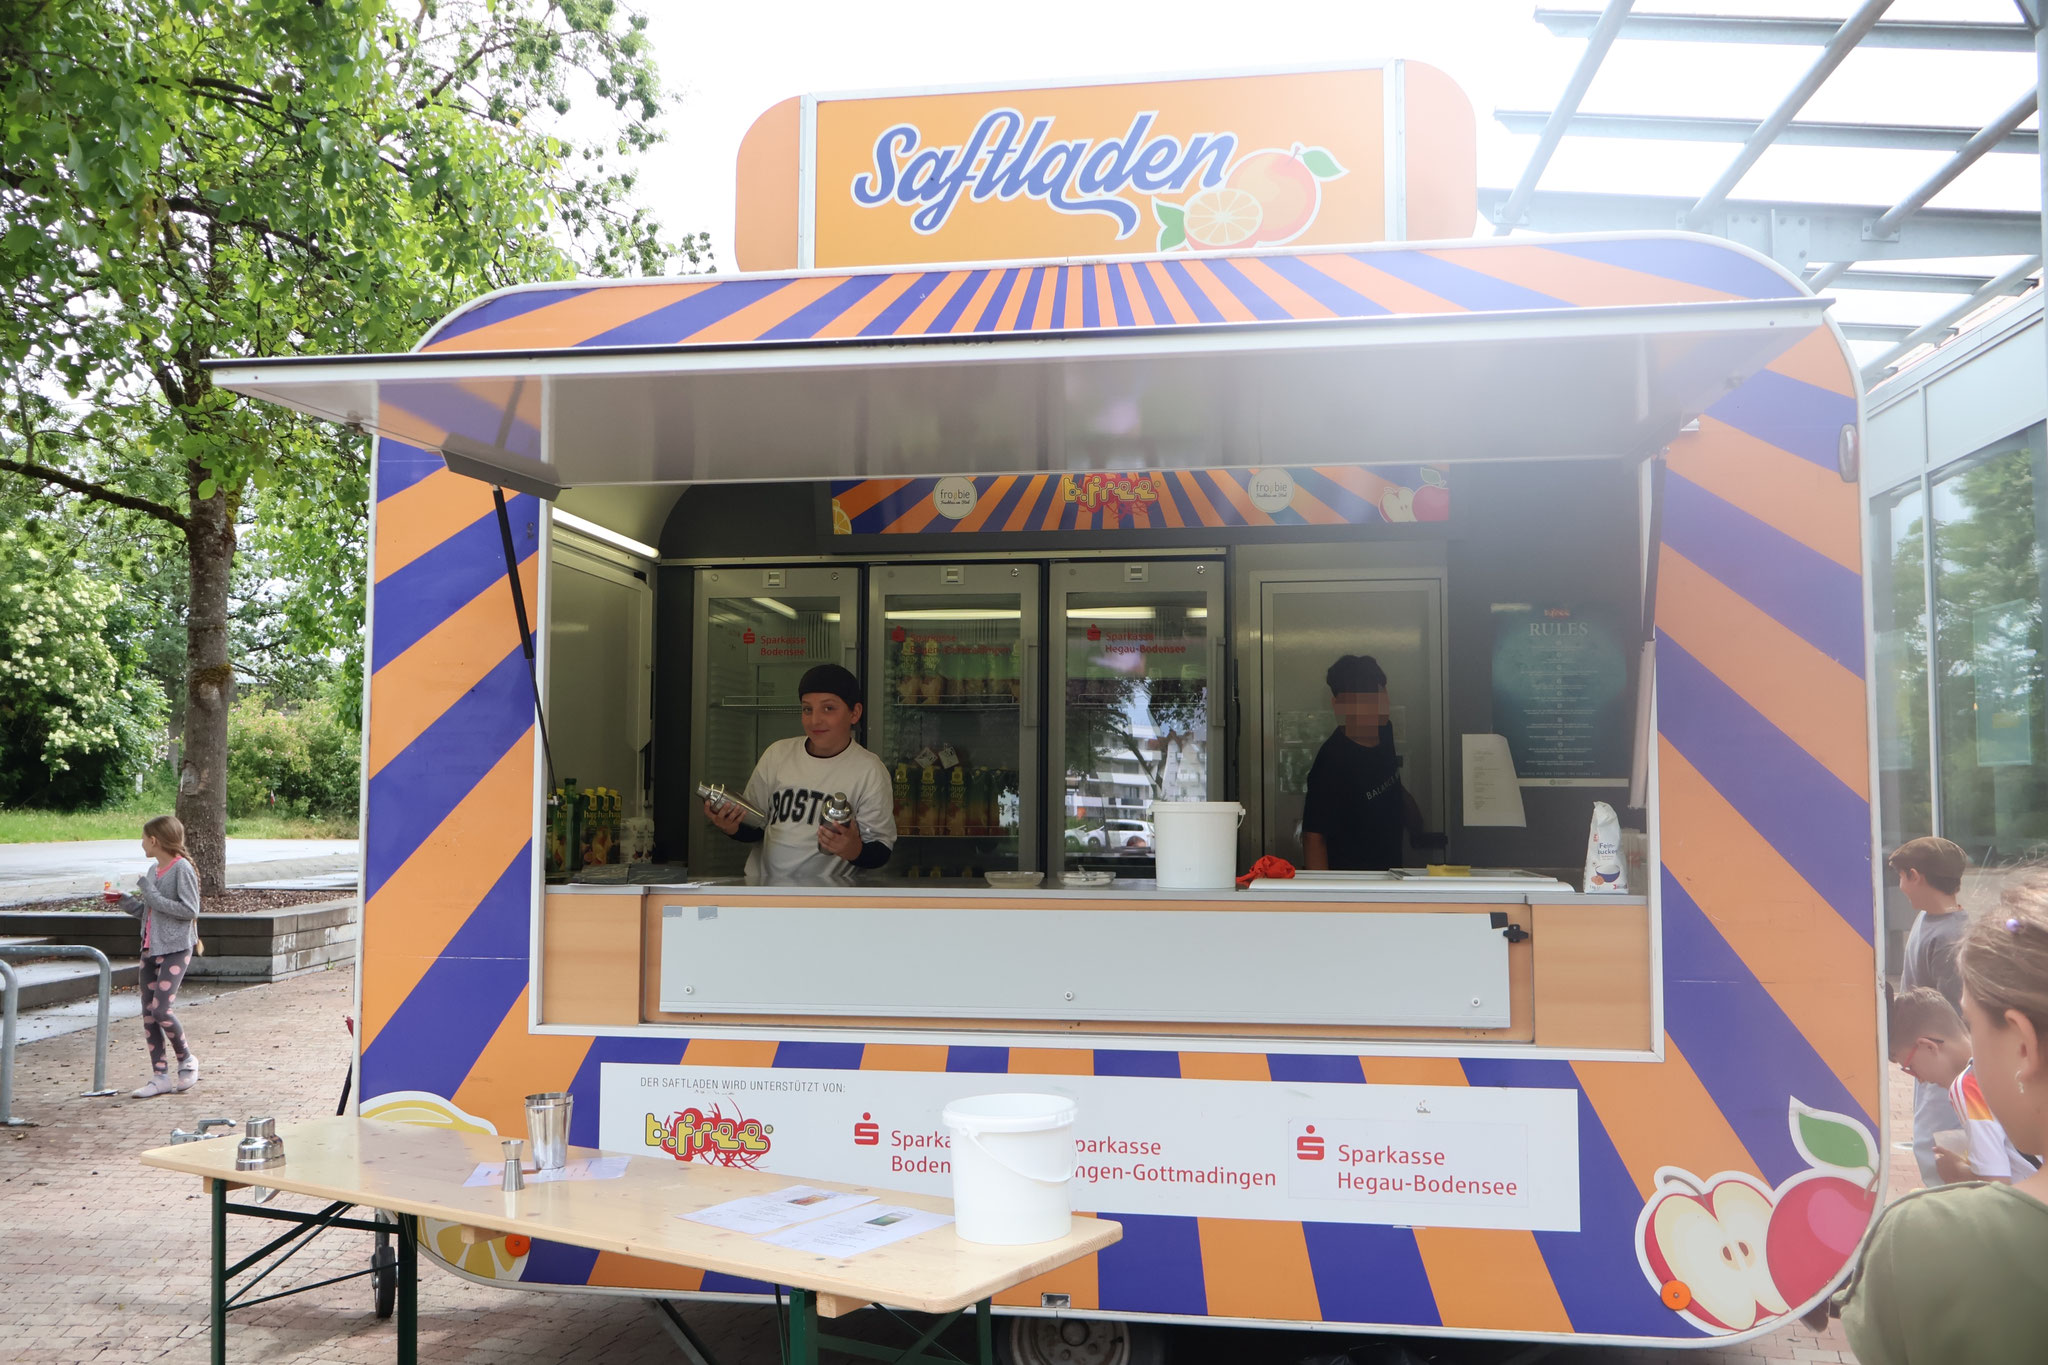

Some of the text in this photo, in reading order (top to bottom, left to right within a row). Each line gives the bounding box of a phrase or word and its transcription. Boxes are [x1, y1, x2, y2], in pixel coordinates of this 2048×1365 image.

[851, 107, 1239, 241] Saftladen
[1105, 632, 1155, 642] Sparkasse
[1529, 622, 1589, 637] RULES
[760, 635, 806, 646] Sparkasse
[1105, 644, 1186, 656] Hegau-Bodensee
[760, 647, 806, 656] Bodensee
[771, 788, 837, 825] BOST
[640, 1076, 846, 1094] DER SAFTLADEN WIRD UNTERSTÜTZT VON:
[645, 1112, 768, 1156] b.free
[890, 1130, 952, 1151] Sparka
[1075, 1135, 1162, 1156] parkasse
[1338, 1144, 1446, 1167] Sparkasse
[892, 1155, 952, 1174] Boden
[1075, 1163, 1278, 1190] ngen-Gottmadingen
[1337, 1171, 1518, 1196] Hegau-Bodensee
